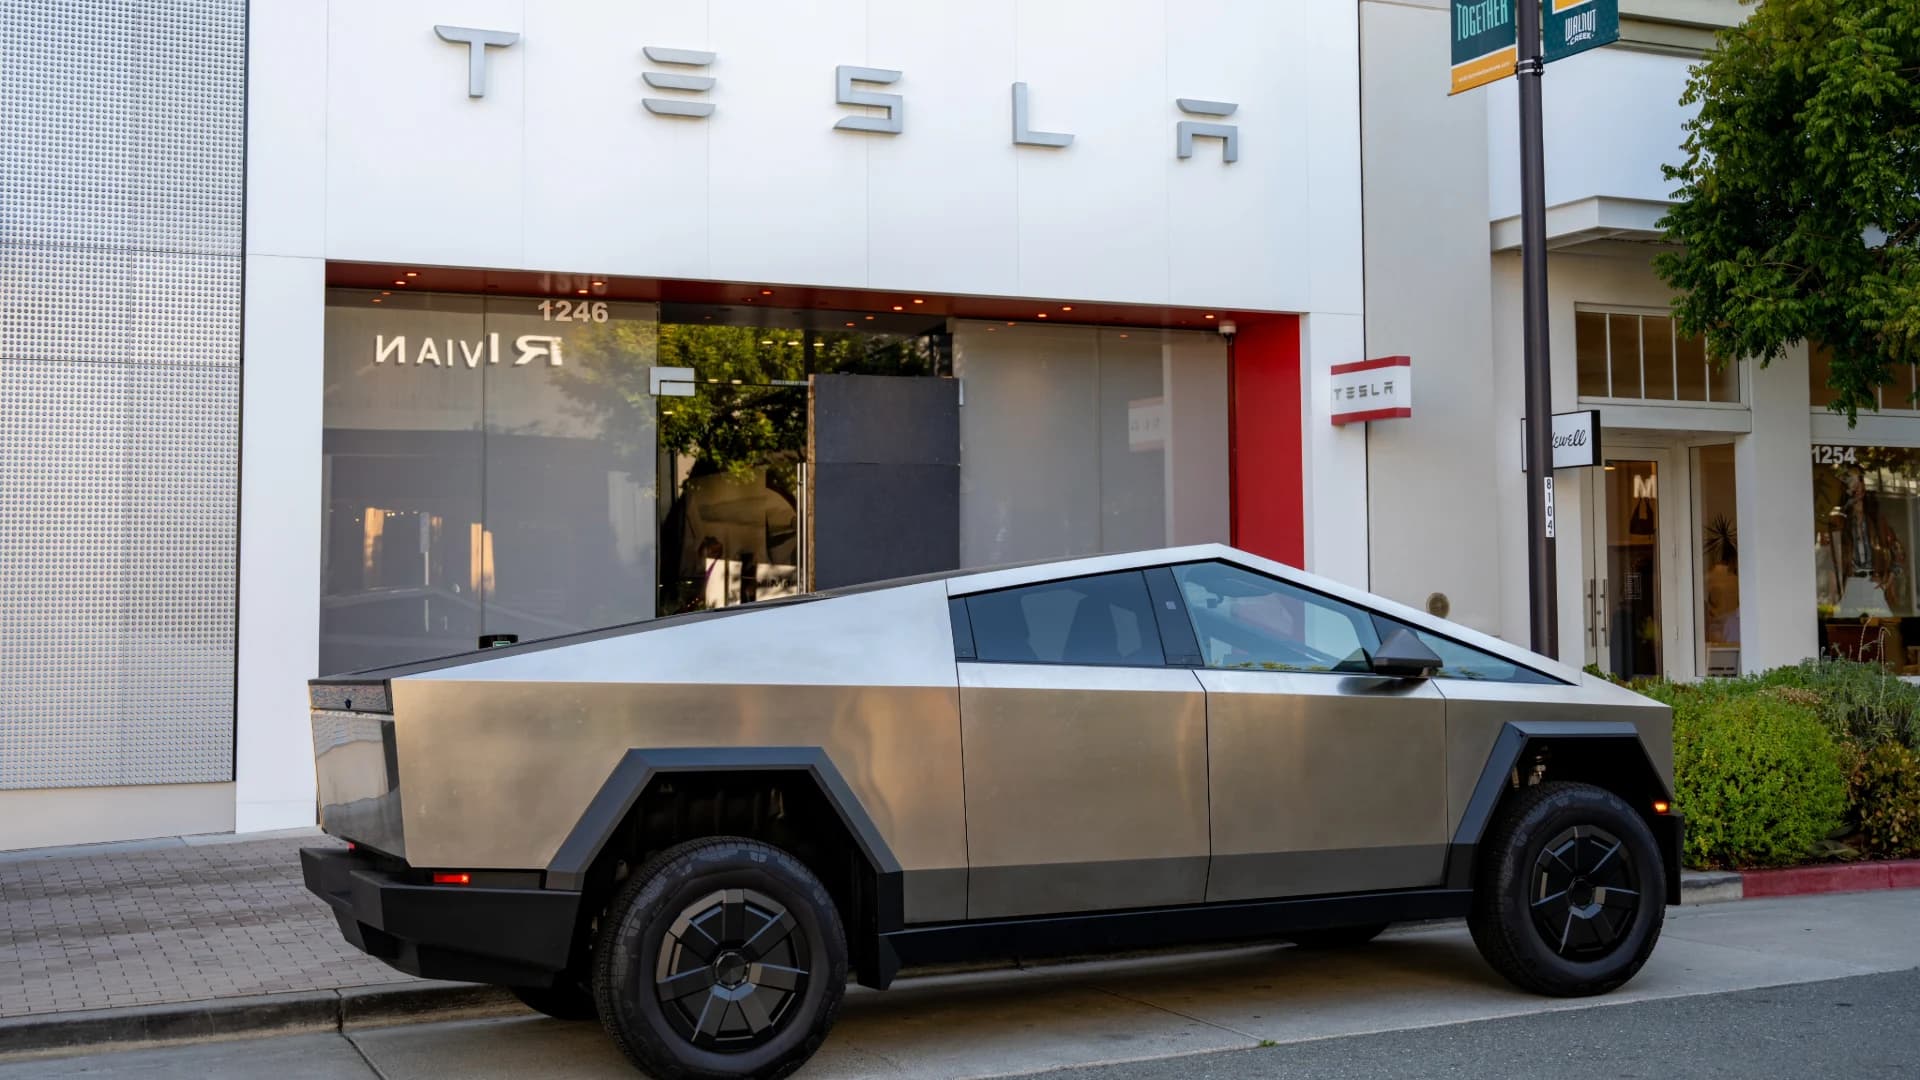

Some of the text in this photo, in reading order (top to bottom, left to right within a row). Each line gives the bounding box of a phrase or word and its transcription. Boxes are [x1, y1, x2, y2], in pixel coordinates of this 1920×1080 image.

[1456, 0, 1508, 41] TOGETHER
[1565, 9, 1596, 41] WALNUT
[1569, 32, 1592, 45] CREEK
[434, 25, 1239, 164] TESLA
[538, 300, 608, 323] 1246
[1334, 381, 1393, 400] TESLA
[1811, 446, 1856, 464] 1254
